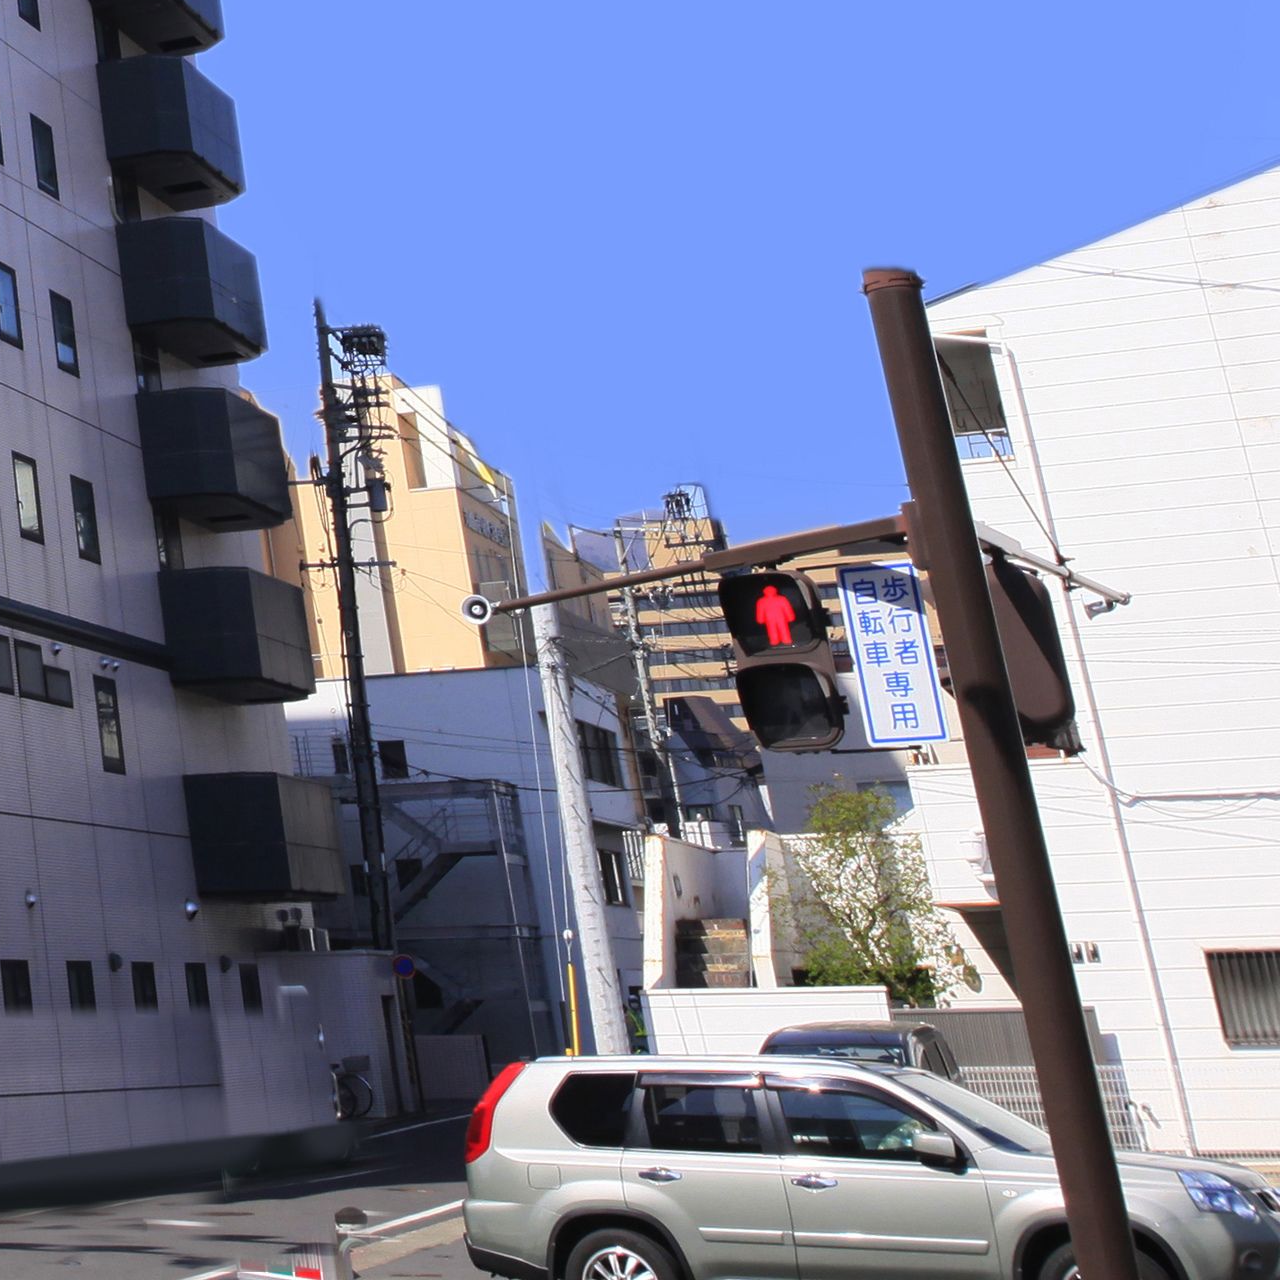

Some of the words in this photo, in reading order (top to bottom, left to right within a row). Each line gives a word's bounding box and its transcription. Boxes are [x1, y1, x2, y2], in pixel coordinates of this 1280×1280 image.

[852, 578, 891, 668] 自転車
[881, 575, 920, 665] 歩行者
[882, 671, 920, 730] 専用
